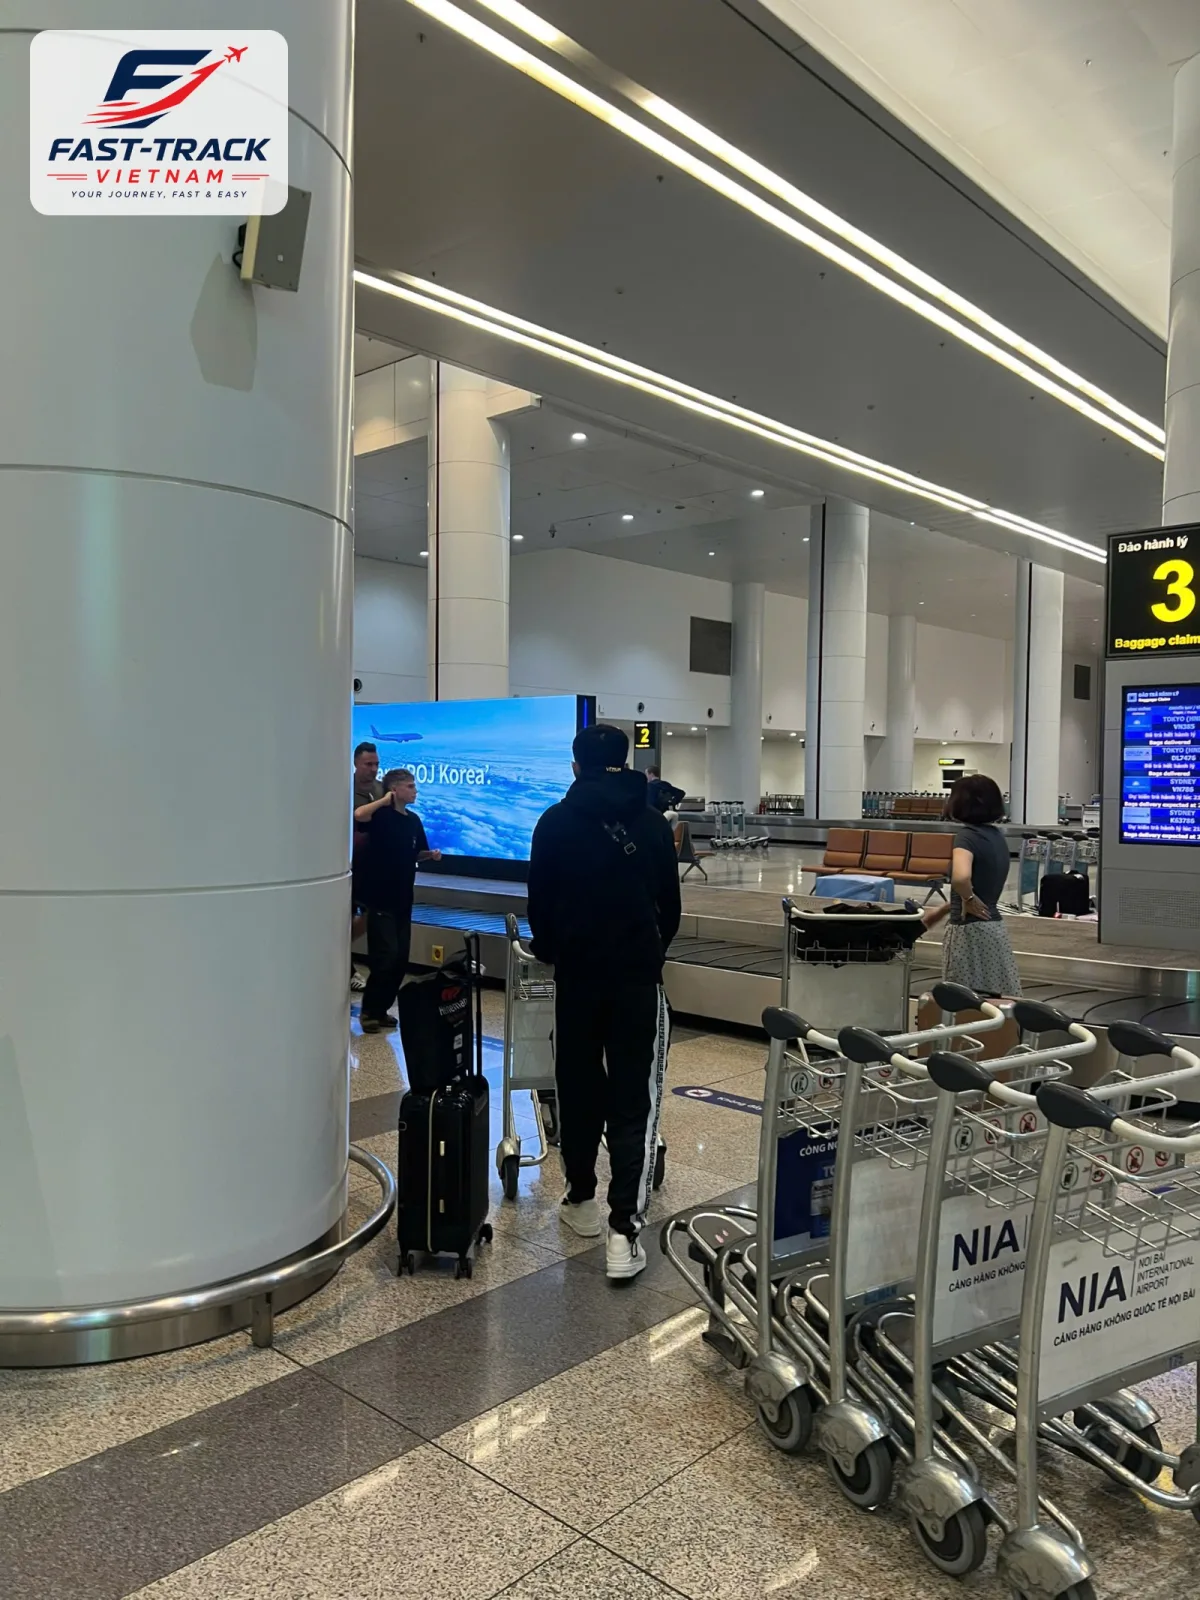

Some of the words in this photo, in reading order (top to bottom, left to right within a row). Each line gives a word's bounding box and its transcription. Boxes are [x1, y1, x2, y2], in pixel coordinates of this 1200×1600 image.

[1118, 541, 1142, 553] Đảo
[1143, 537, 1174, 550] hành
[1177, 535, 1188, 549] lý
[1151, 559, 1196, 623] 3
[1115, 637, 1166, 650] Baggage
[641, 728, 649, 743] 2
[952, 1219, 1020, 1272] NIA
[949, 1277, 972, 1293] CẢNG
[973, 1269, 996, 1285] HÀNG
[998, 1260, 1026, 1277] KHÔNG
[1137, 1256, 1195, 1283] INTERNATIONAL
[1058, 1265, 1127, 1324] NIA
[1136, 1276, 1169, 1296] AIRPORT
[1053, 1330, 1078, 1347] CẢNG
[1079, 1321, 1102, 1338] HÀNG
[1103, 1310, 1132, 1329] KHÔNG
[1133, 1302, 1155, 1318] QUỐC
[1157, 1296, 1167, 1310] TẾ
[1168, 1293, 1182, 1307] NỘI
[1182, 1288, 1196, 1302] BÀI
